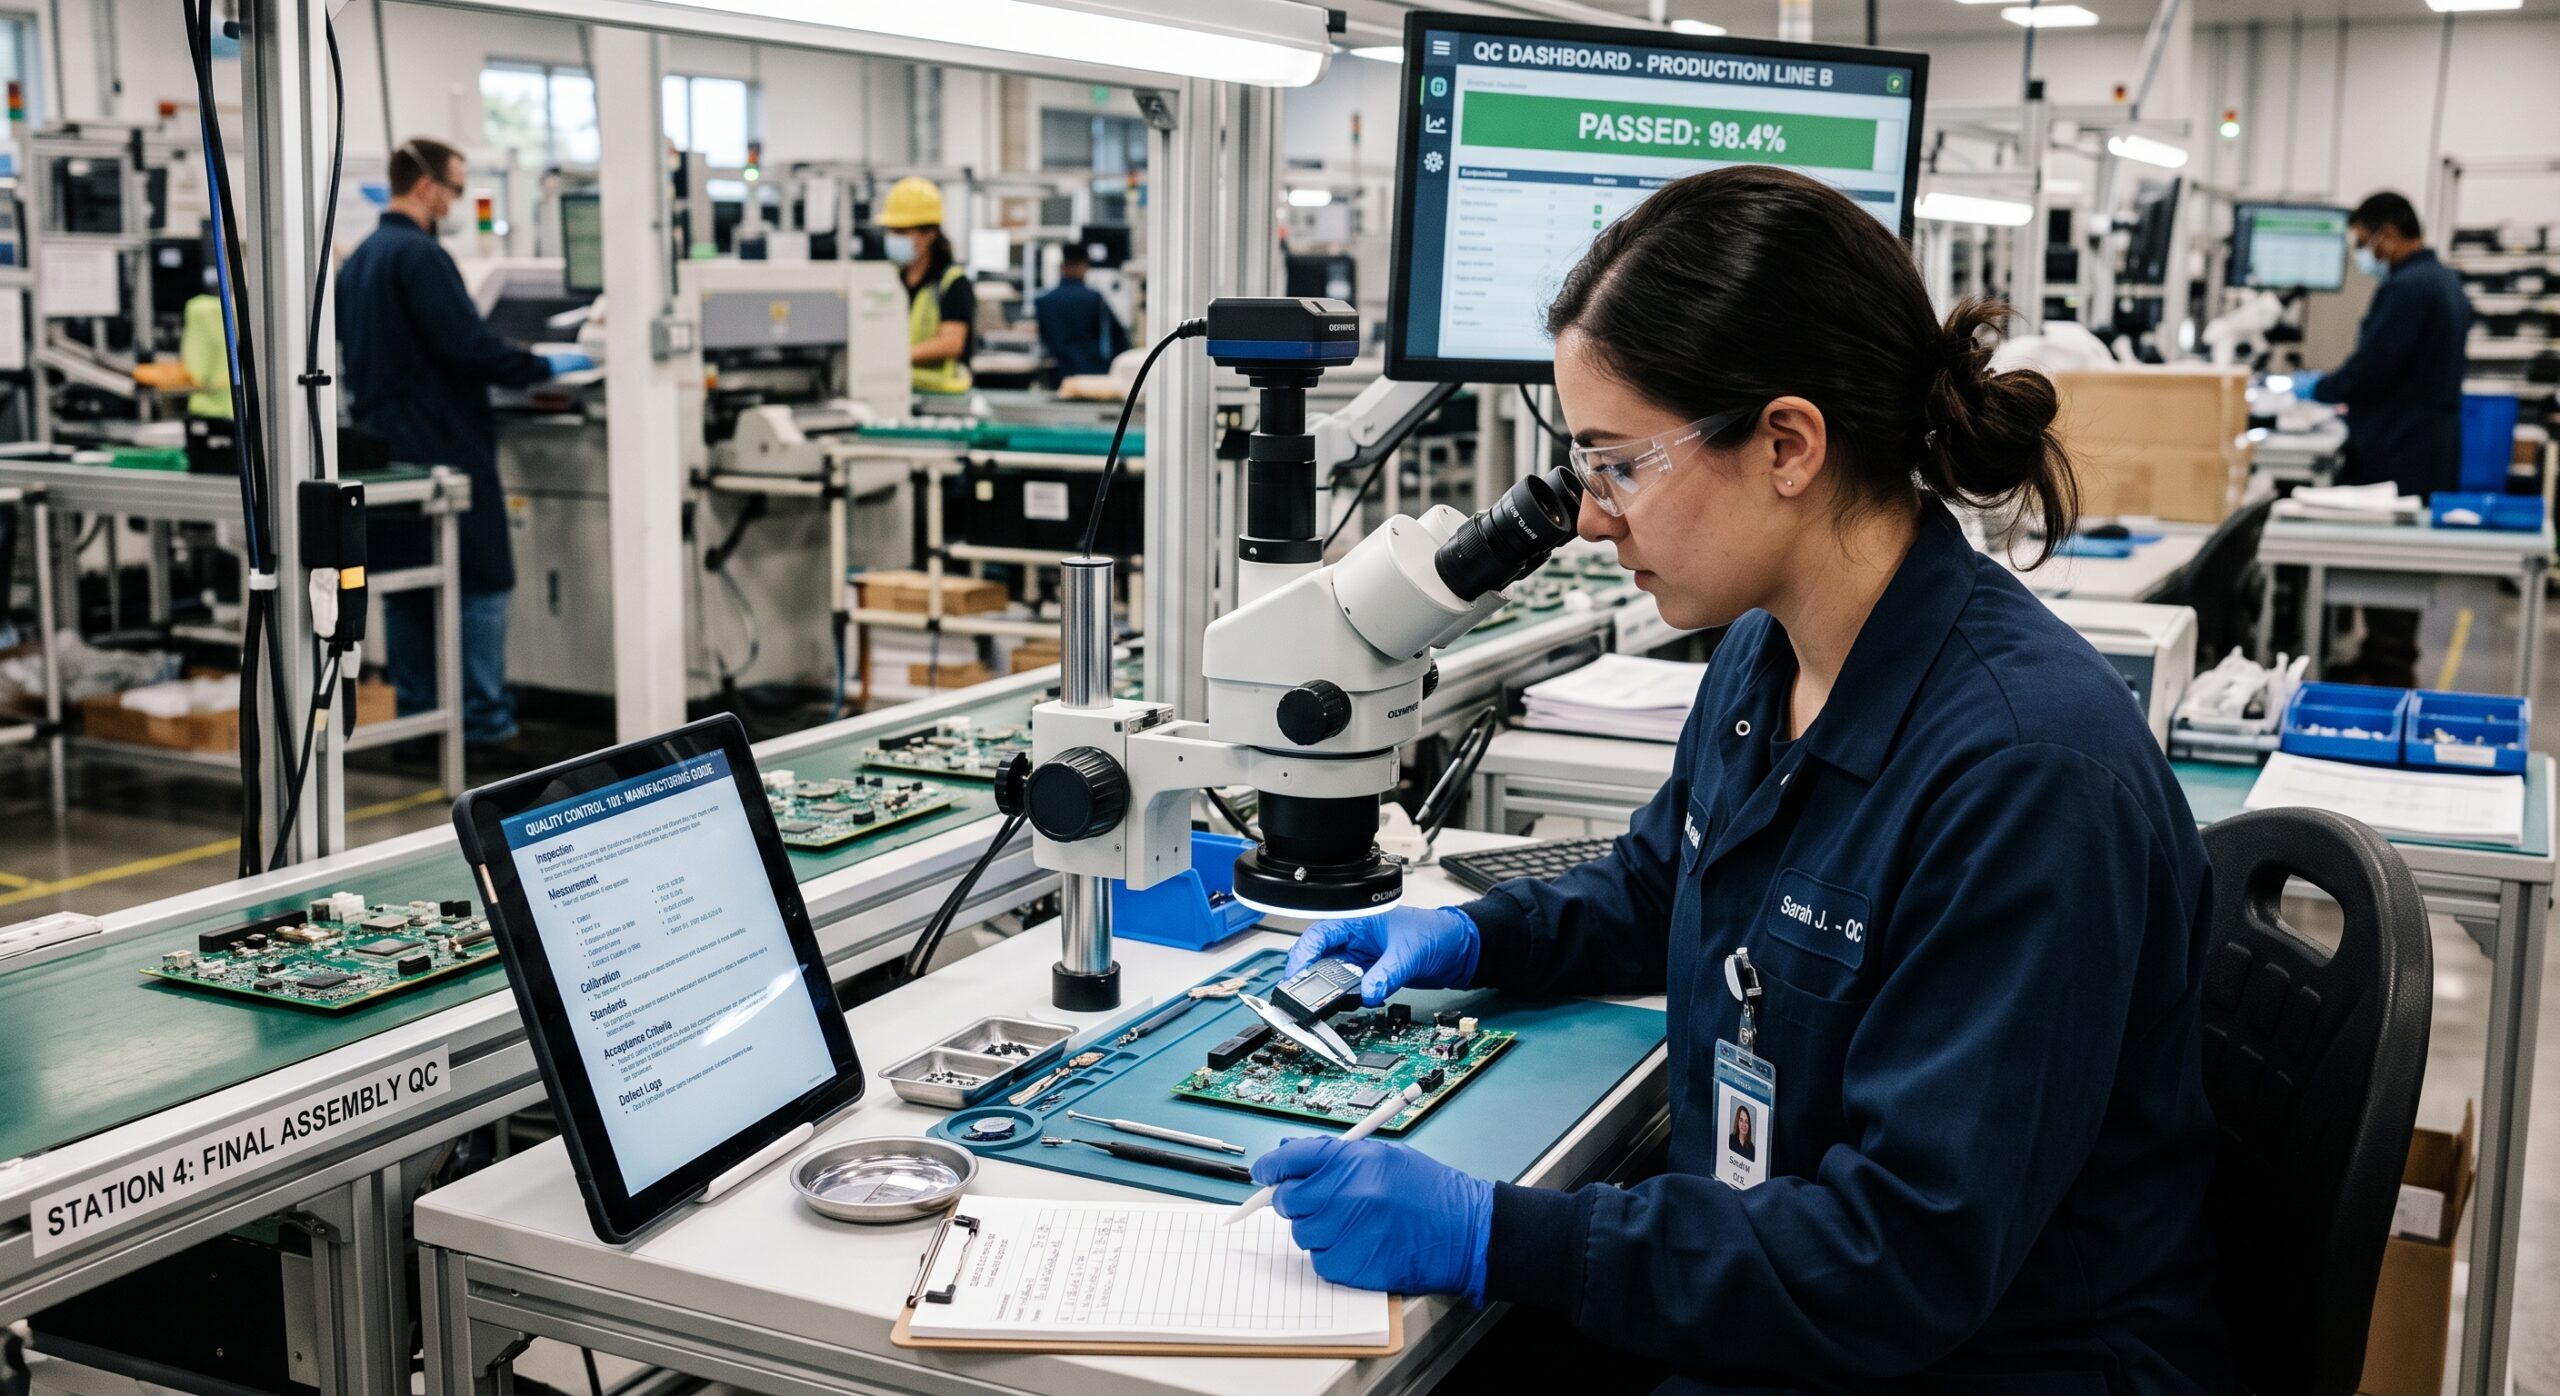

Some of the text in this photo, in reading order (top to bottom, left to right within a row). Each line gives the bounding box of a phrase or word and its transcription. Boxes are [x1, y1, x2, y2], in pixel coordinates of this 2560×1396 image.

[1474, 41, 1503, 63] QC
[1508, 43, 1632, 72] DASHBOARD
[1647, 54, 1771, 83] PRODUCTION
[1774, 65, 1816, 87] LINE
[1819, 68, 1834, 88] B
[1578, 112, 1787, 153] PASSED: 98.4%
[525, 811, 564, 838] QUALITY
[564, 799, 606, 825] CONTROL
[1780, 895, 1812, 926] Sarah
[1814, 910, 1828, 931] J.
[1845, 919, 1864, 943] QC
[589, 997, 628, 1022] Standards
[47, 1061, 439, 1237] STATION 4: FINAL ASSEMBLY QC
